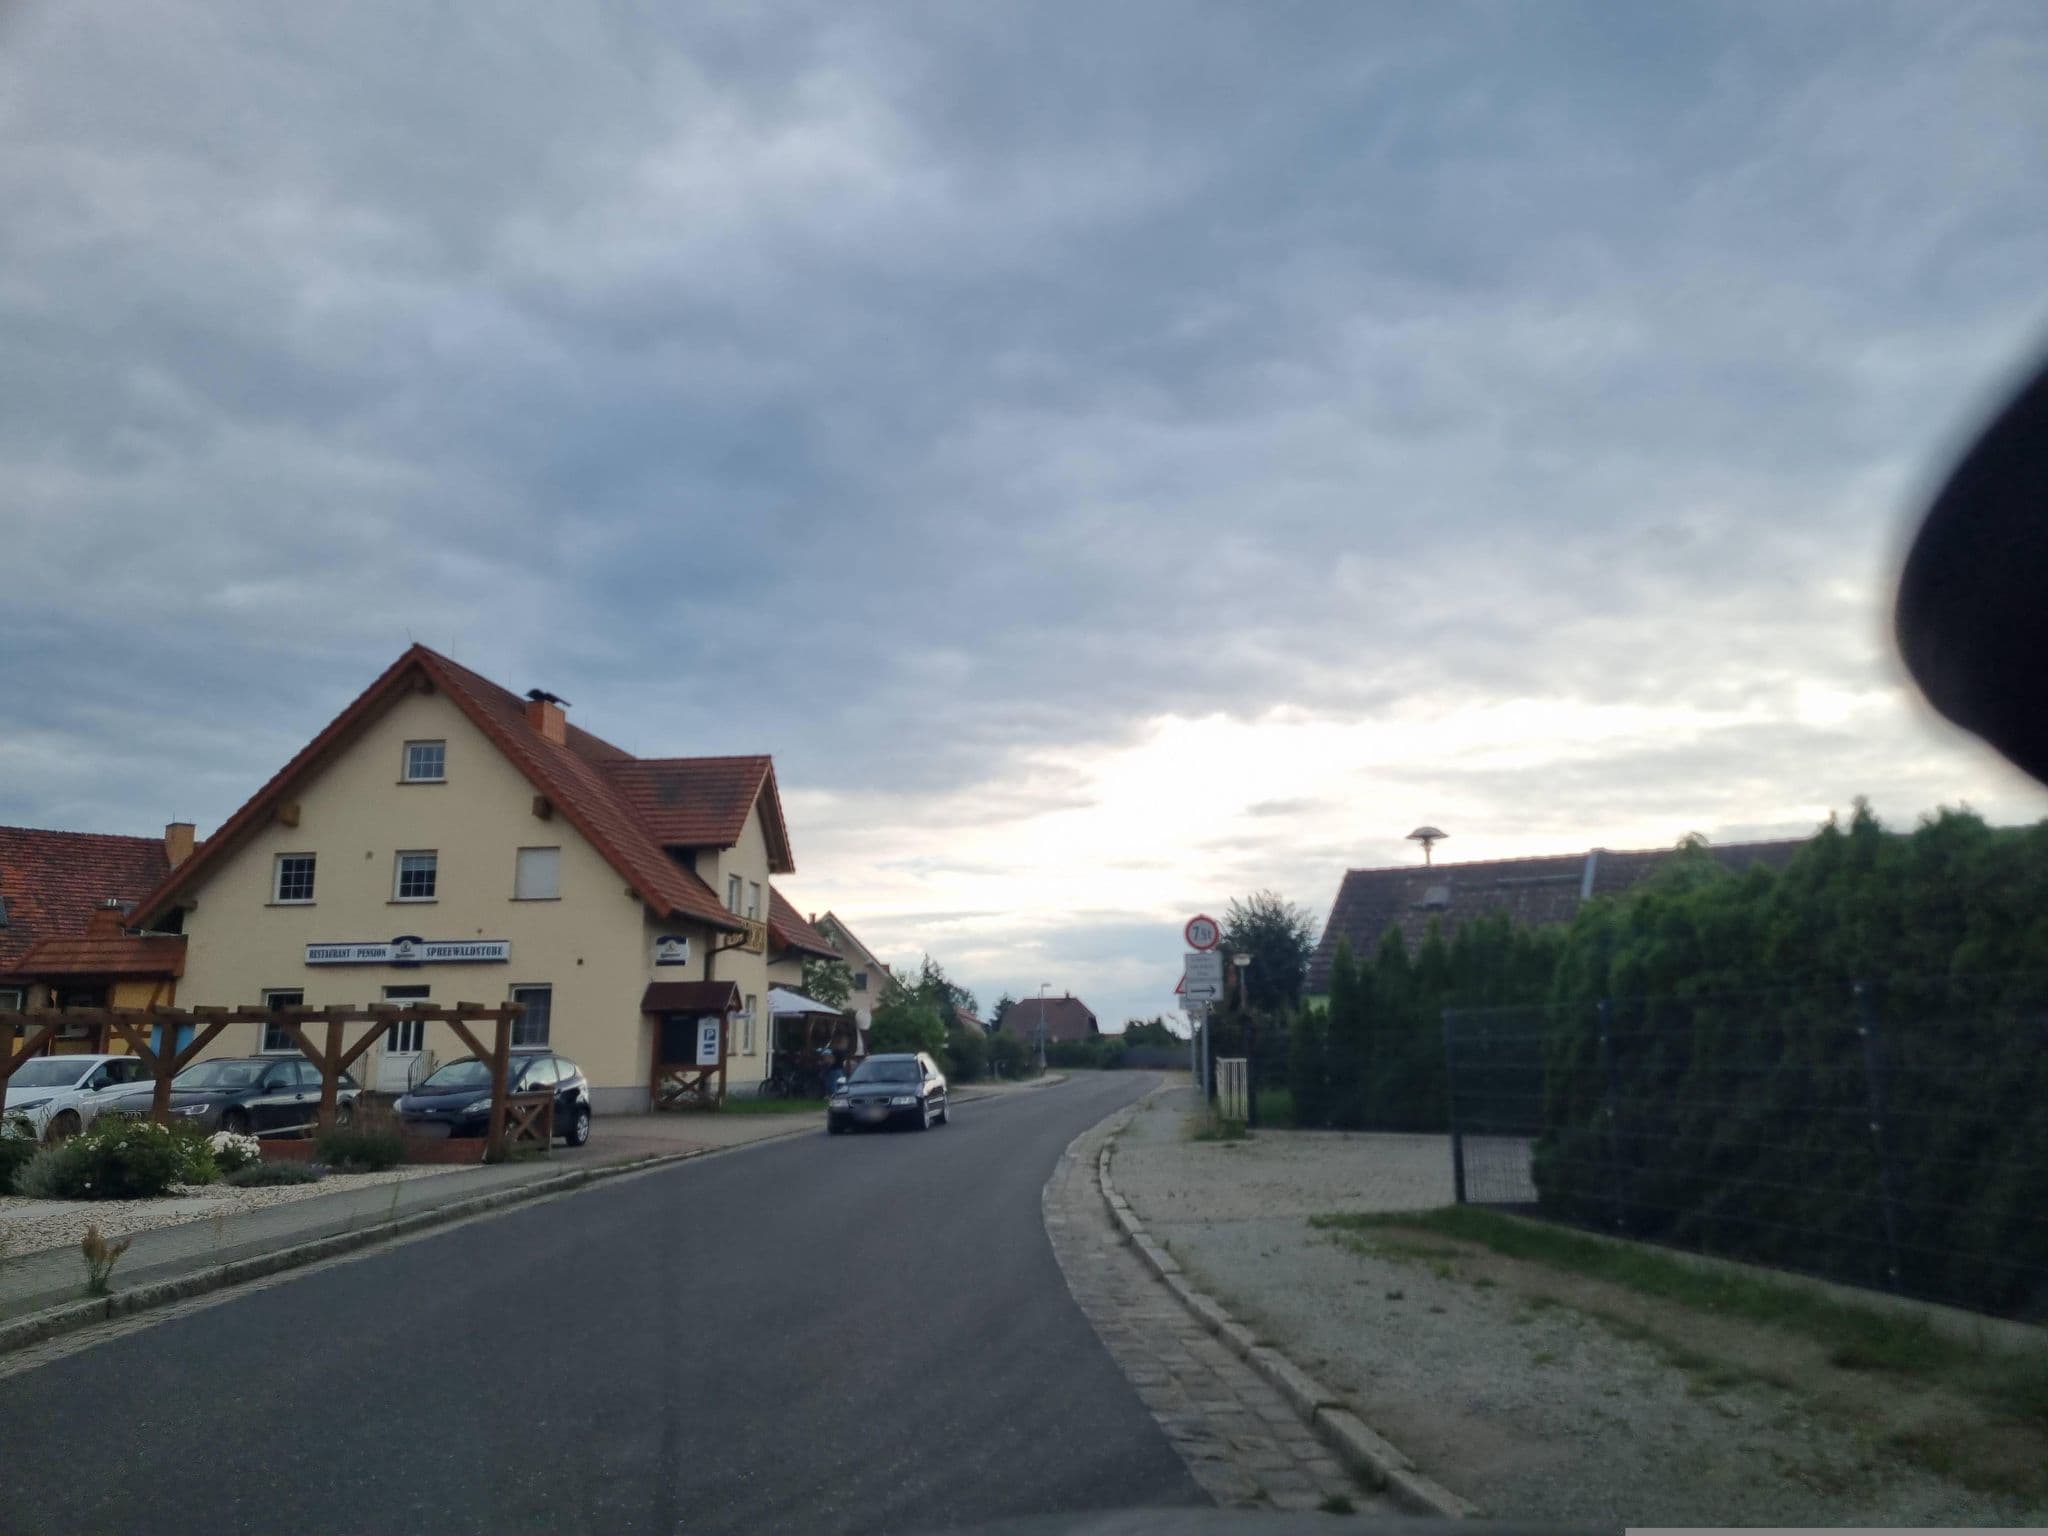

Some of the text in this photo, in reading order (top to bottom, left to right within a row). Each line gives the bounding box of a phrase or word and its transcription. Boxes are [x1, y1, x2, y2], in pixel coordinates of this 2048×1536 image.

[309, 949, 350, 959] RESTAURANT
[357, 948, 387, 958] PENSION
[426, 946, 504, 957] SPREEWALDSTUBE
